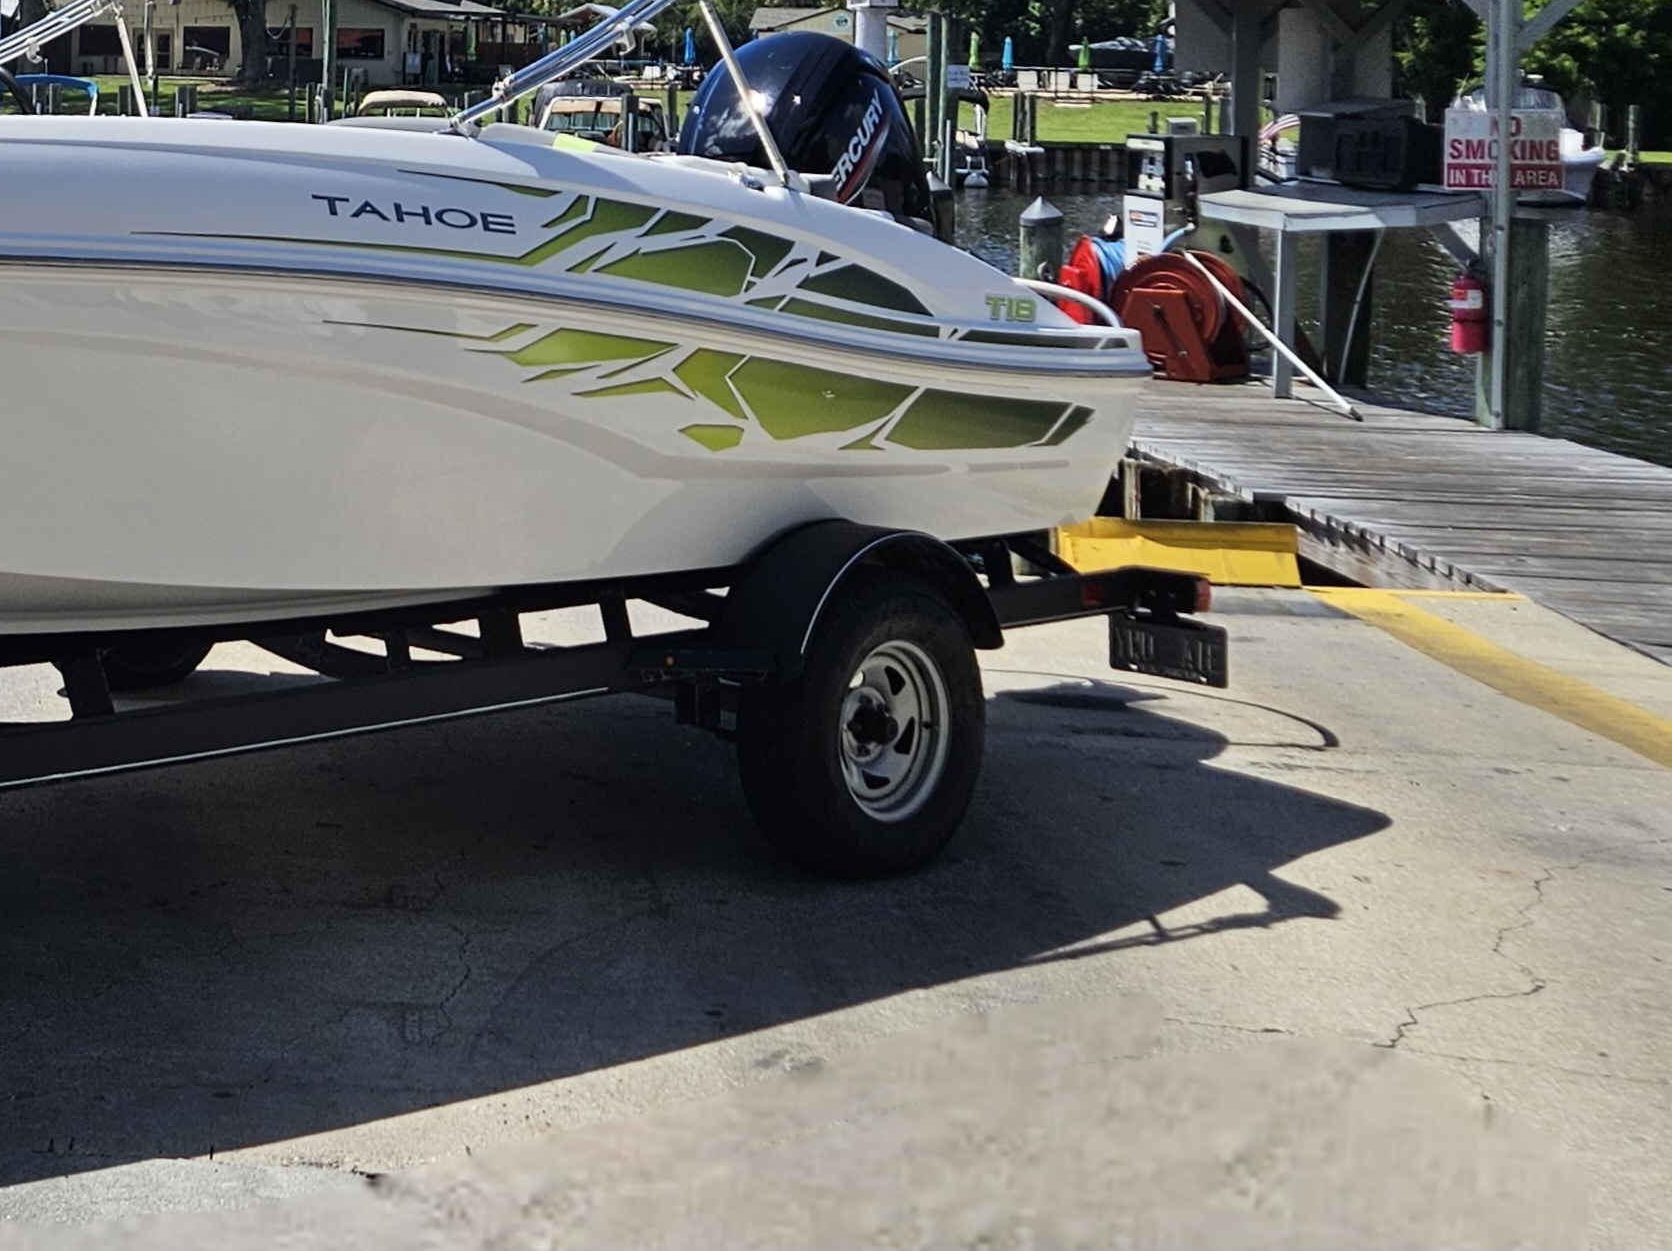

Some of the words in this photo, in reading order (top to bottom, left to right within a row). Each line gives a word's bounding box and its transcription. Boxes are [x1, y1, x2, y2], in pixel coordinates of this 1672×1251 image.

[831, 88, 883, 191] ERCURY
[1449, 169, 1466, 186] IN
[1471, 169, 1502, 186] TH
[1514, 169, 1559, 186] AREA
[311, 193, 517, 235] TAHOE
